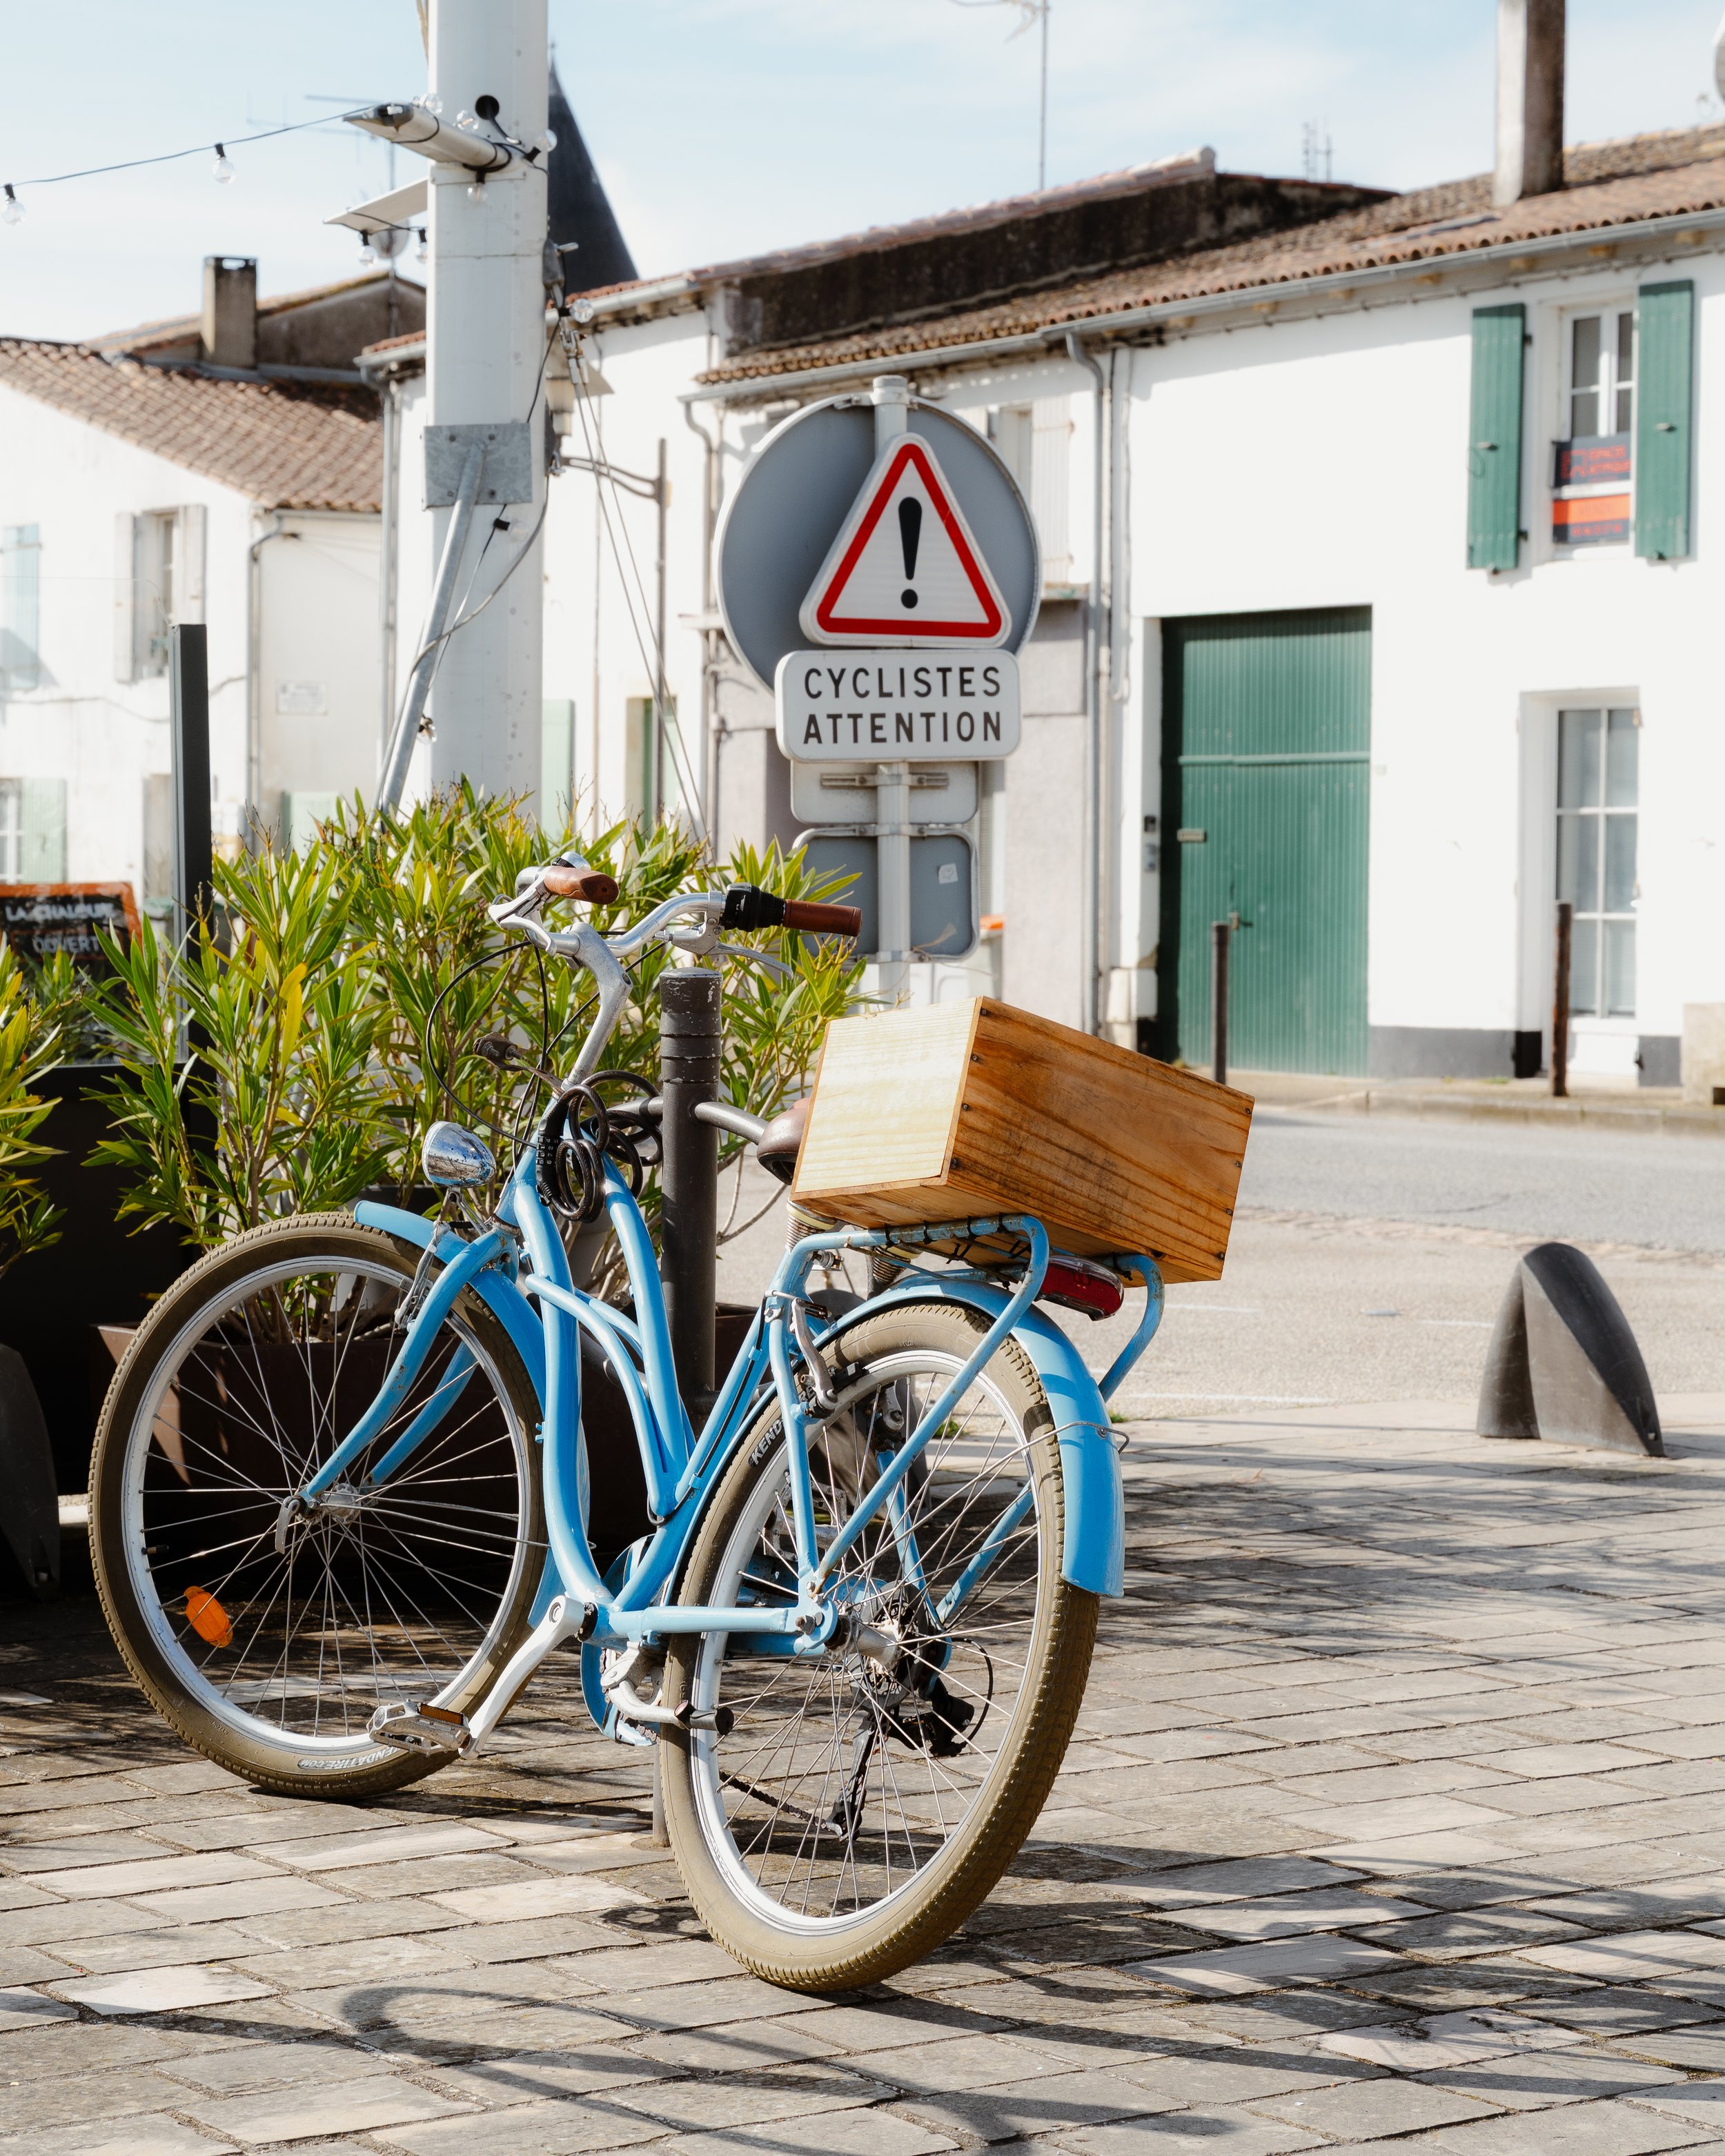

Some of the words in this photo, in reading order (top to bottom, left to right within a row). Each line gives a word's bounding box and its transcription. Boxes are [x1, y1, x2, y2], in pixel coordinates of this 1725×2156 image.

[804, 666, 1000, 699] CYCLISTES
[803, 711, 1001, 744] ATTENTION
[32, 936, 99, 953] OUVERT
[751, 1418, 784, 1465] KEND
